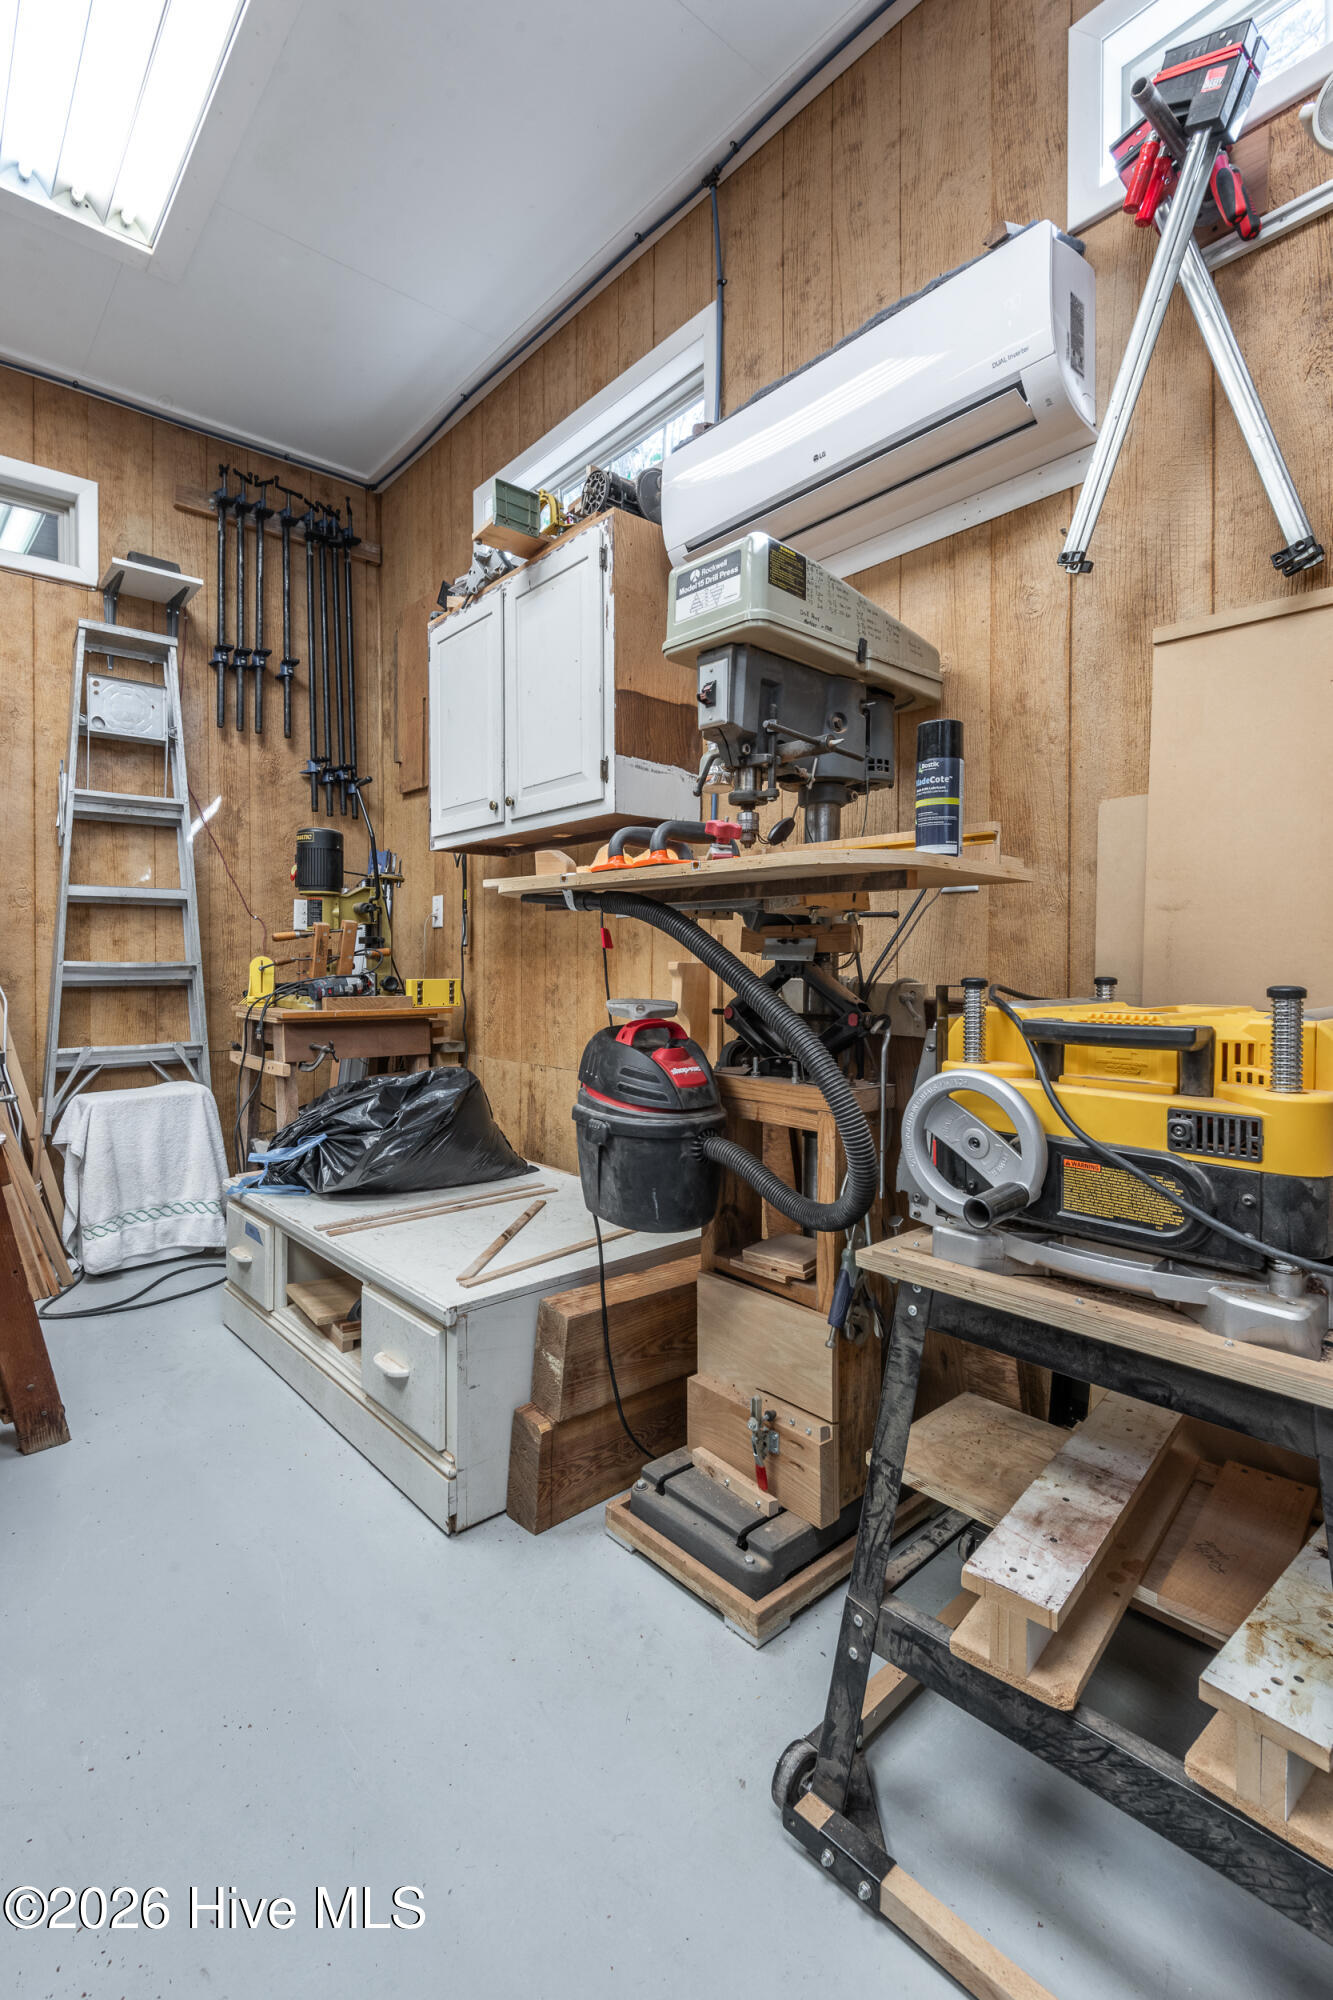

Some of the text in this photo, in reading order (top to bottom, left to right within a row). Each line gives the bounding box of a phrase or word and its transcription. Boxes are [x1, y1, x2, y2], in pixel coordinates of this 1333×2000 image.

[992, 346, 1029, 369] DUAL Inverter
[701, 559, 728, 576] Rockwell
[678, 582, 697, 596] Model
[705, 573, 719, 585] Drill
[720, 566, 739, 579] Press
[1070, 1161, 1101, 1171] WARNING
